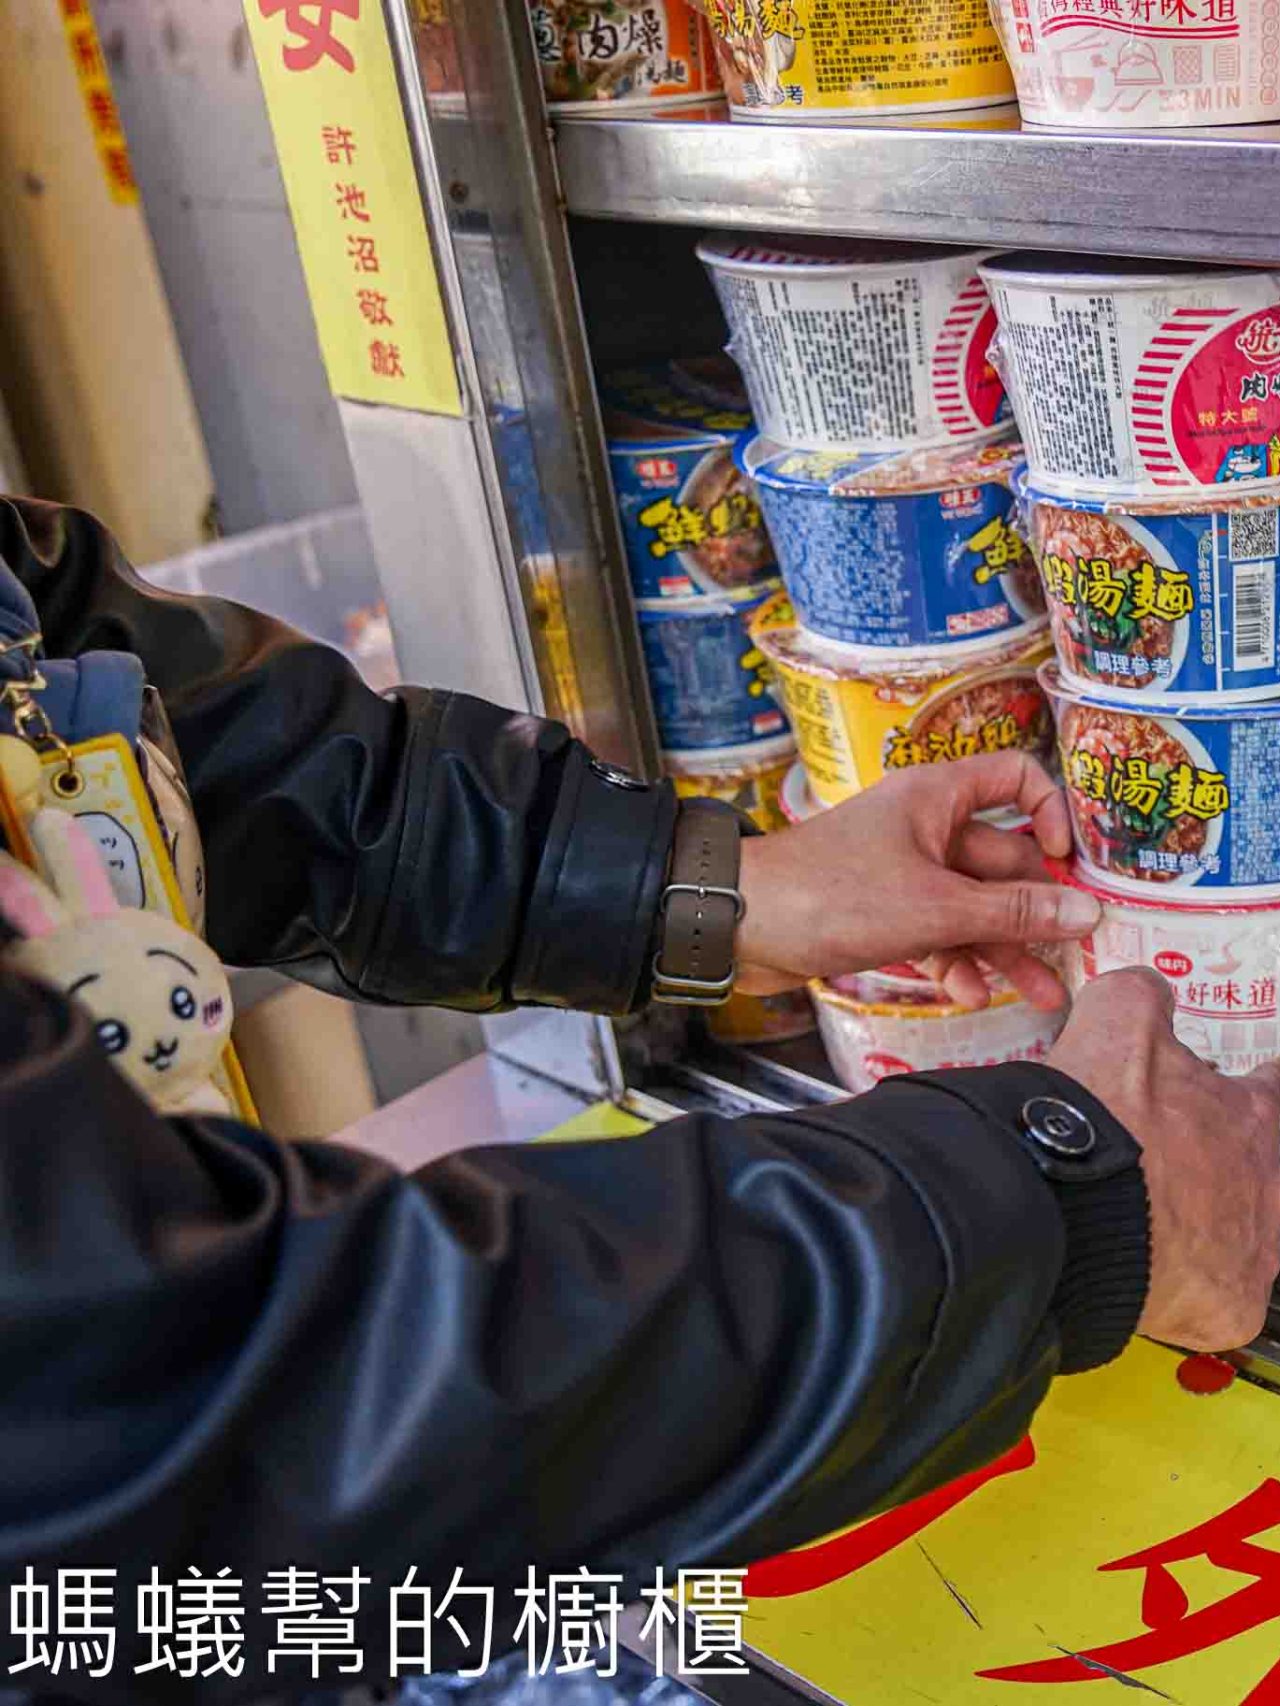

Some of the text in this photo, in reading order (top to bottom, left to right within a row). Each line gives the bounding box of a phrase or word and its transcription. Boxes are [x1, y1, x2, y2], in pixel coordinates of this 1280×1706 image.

[1198, 406, 1259, 427] 特大號
[1094, 652, 1174, 679] 調理參考
[1138, 850, 1222, 875] 調理參考
[1172, 977, 1278, 1010] 好味道
